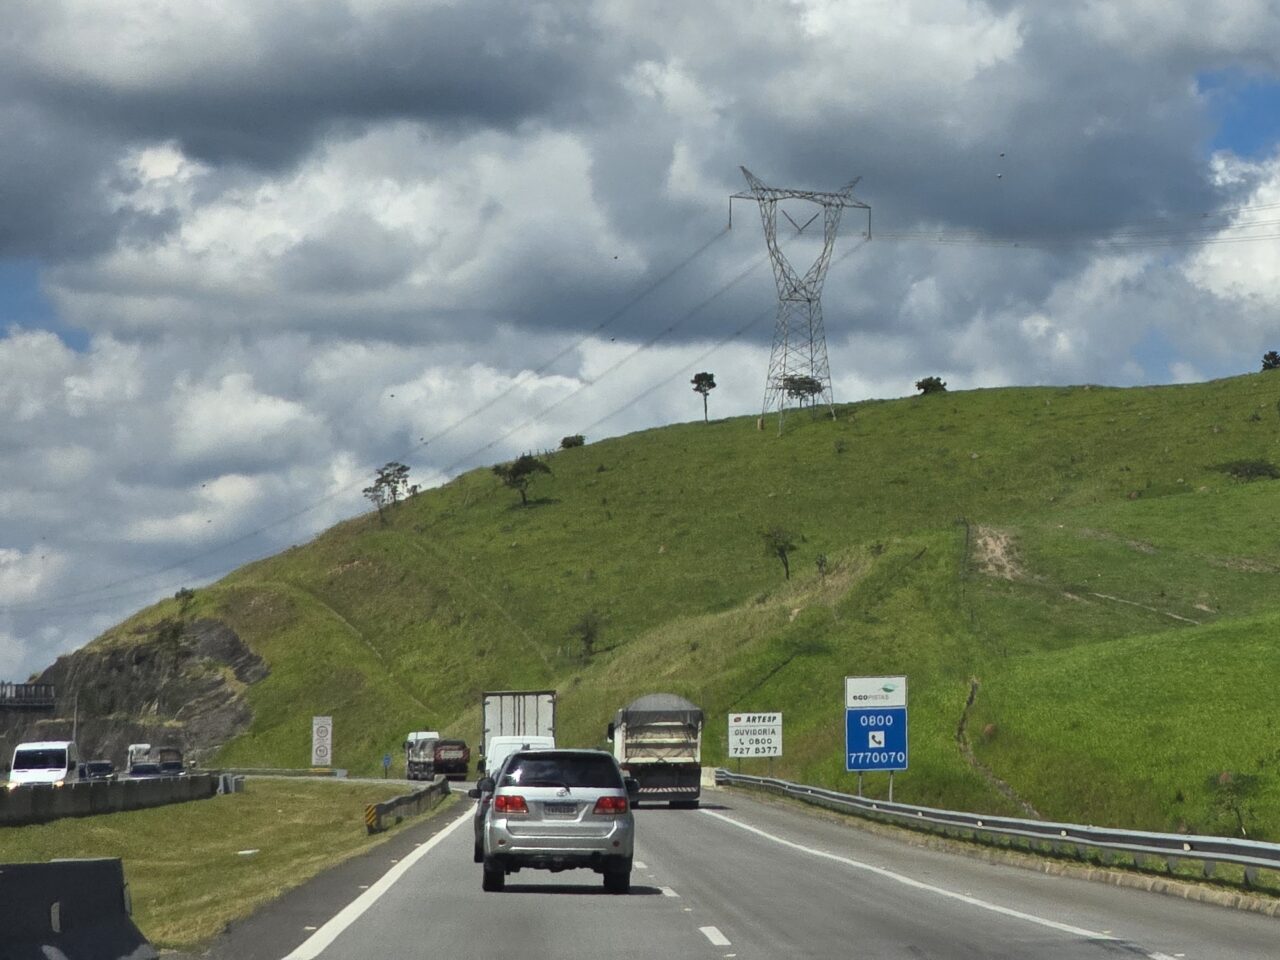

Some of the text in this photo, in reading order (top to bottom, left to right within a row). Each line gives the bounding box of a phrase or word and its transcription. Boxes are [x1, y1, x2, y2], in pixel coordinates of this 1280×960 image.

[745, 715, 777, 724] ARTESP
[860, 715, 894, 727] 0800
[734, 728, 776, 736] OUVIDORIA
[748, 737, 773, 745] 0800
[733, 746, 778, 755] 727 8377
[849, 751, 905, 765] 7770070
